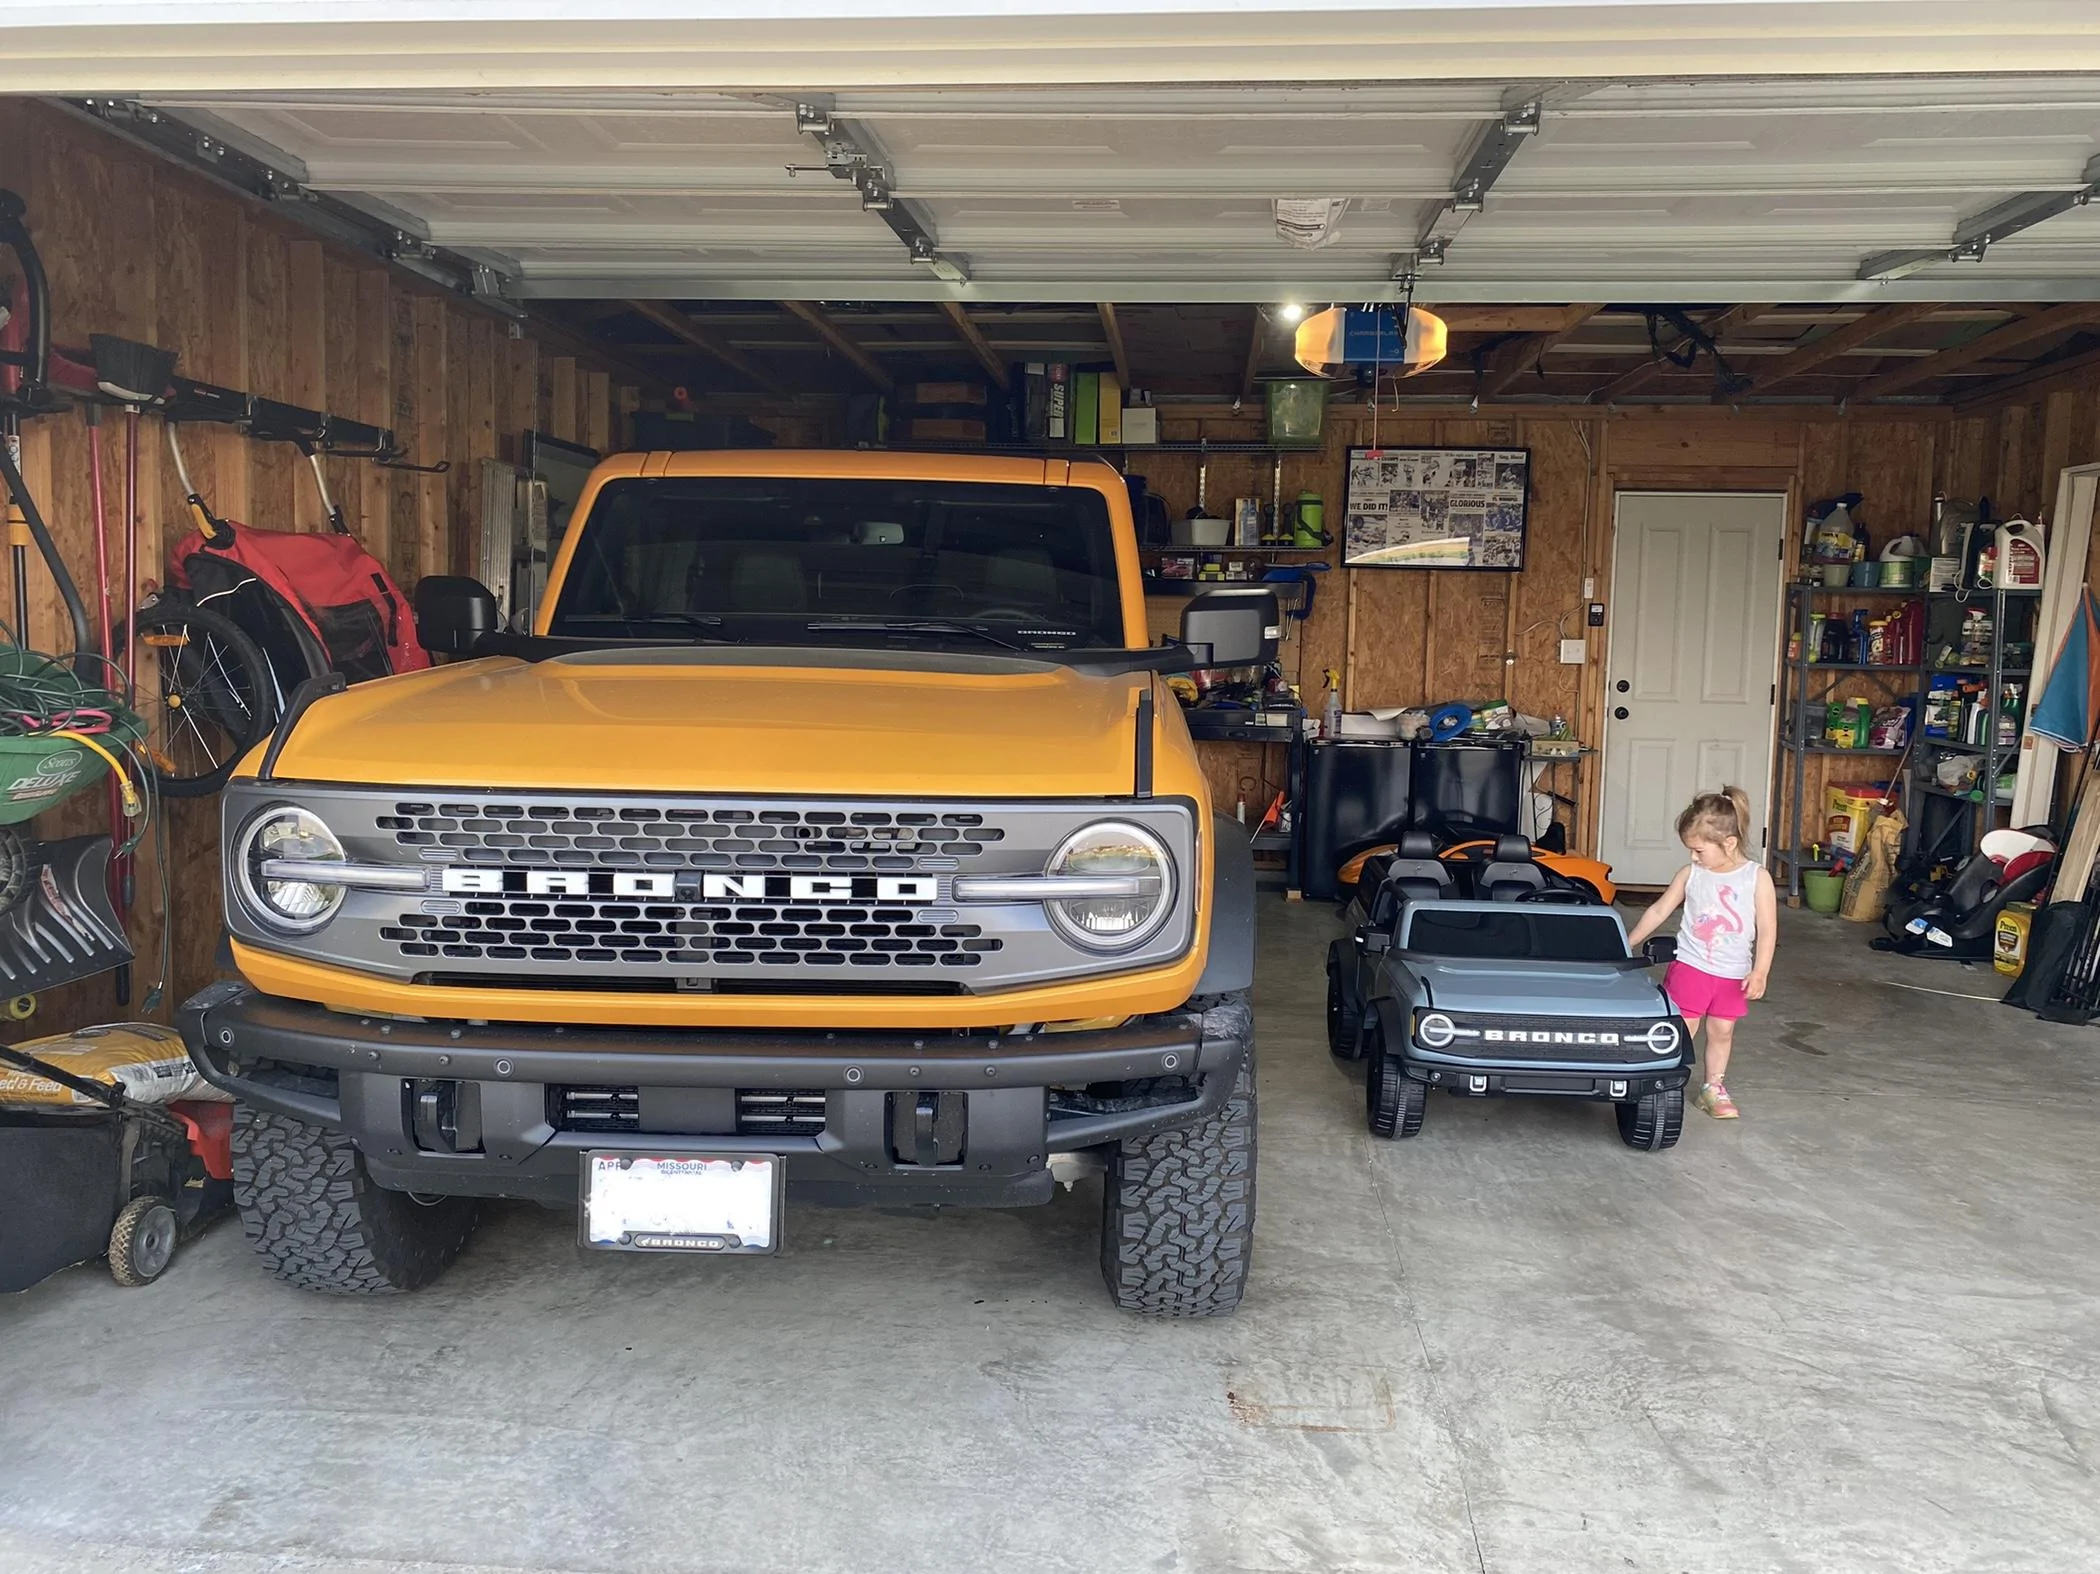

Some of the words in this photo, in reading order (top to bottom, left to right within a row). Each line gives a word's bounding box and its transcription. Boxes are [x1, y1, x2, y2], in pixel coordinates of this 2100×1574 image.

[1053, 383, 1065, 418] SUPER
[1450, 500, 1485, 508] GLORIOUS
[6, 770, 81, 790] DELUXE
[442, 868, 938, 900] BRONCO
[1484, 1029, 1619, 1045] BRONCO
[657, 1161, 707, 1172] MISSOURI
[651, 1239, 719, 1248] BRONCO
